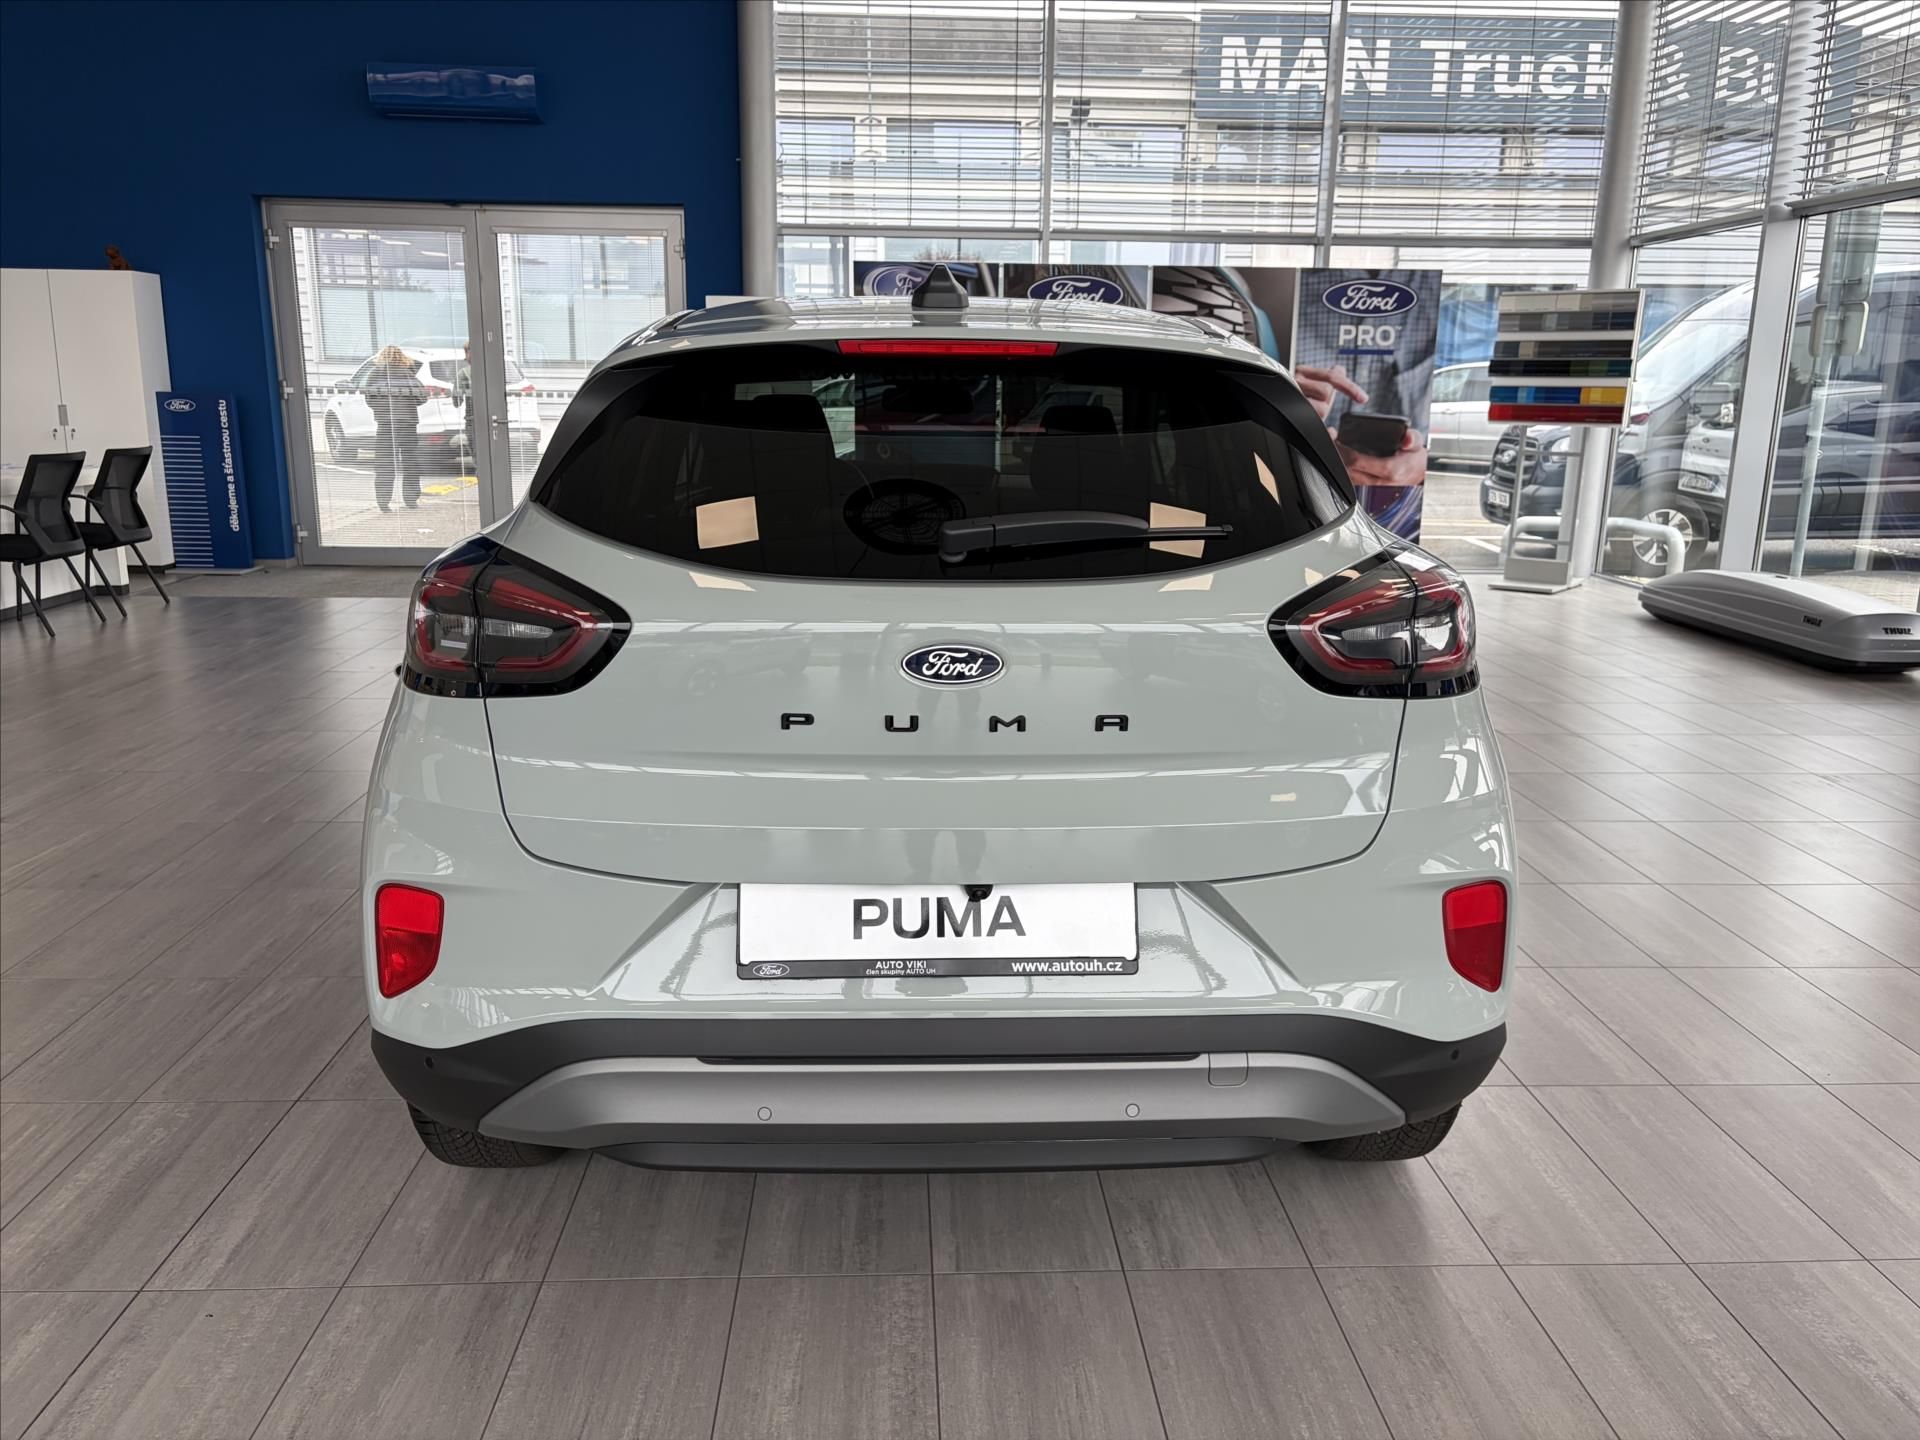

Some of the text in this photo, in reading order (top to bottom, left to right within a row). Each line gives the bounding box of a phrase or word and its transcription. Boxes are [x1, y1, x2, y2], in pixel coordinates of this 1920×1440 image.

[1218, 36, 1391, 96] MAN
[1340, 284, 1400, 311] Ford
[169, 400, 191, 411] Ford
[218, 399, 229, 428] cestu
[227, 475, 235, 483] a
[228, 483, 240, 532] děkujeme
[922, 650, 983, 678] Ford
[780, 712, 1130, 733] PUMA
[852, 895, 1027, 940] PUMA
[759, 965, 783, 976] Ford
[875, 960, 927, 969] AUTO VIKI
[881, 968, 905, 976] skupiny
[926, 967, 936, 975] UH
[1011, 958, 1124, 974] www.autouh.cz
